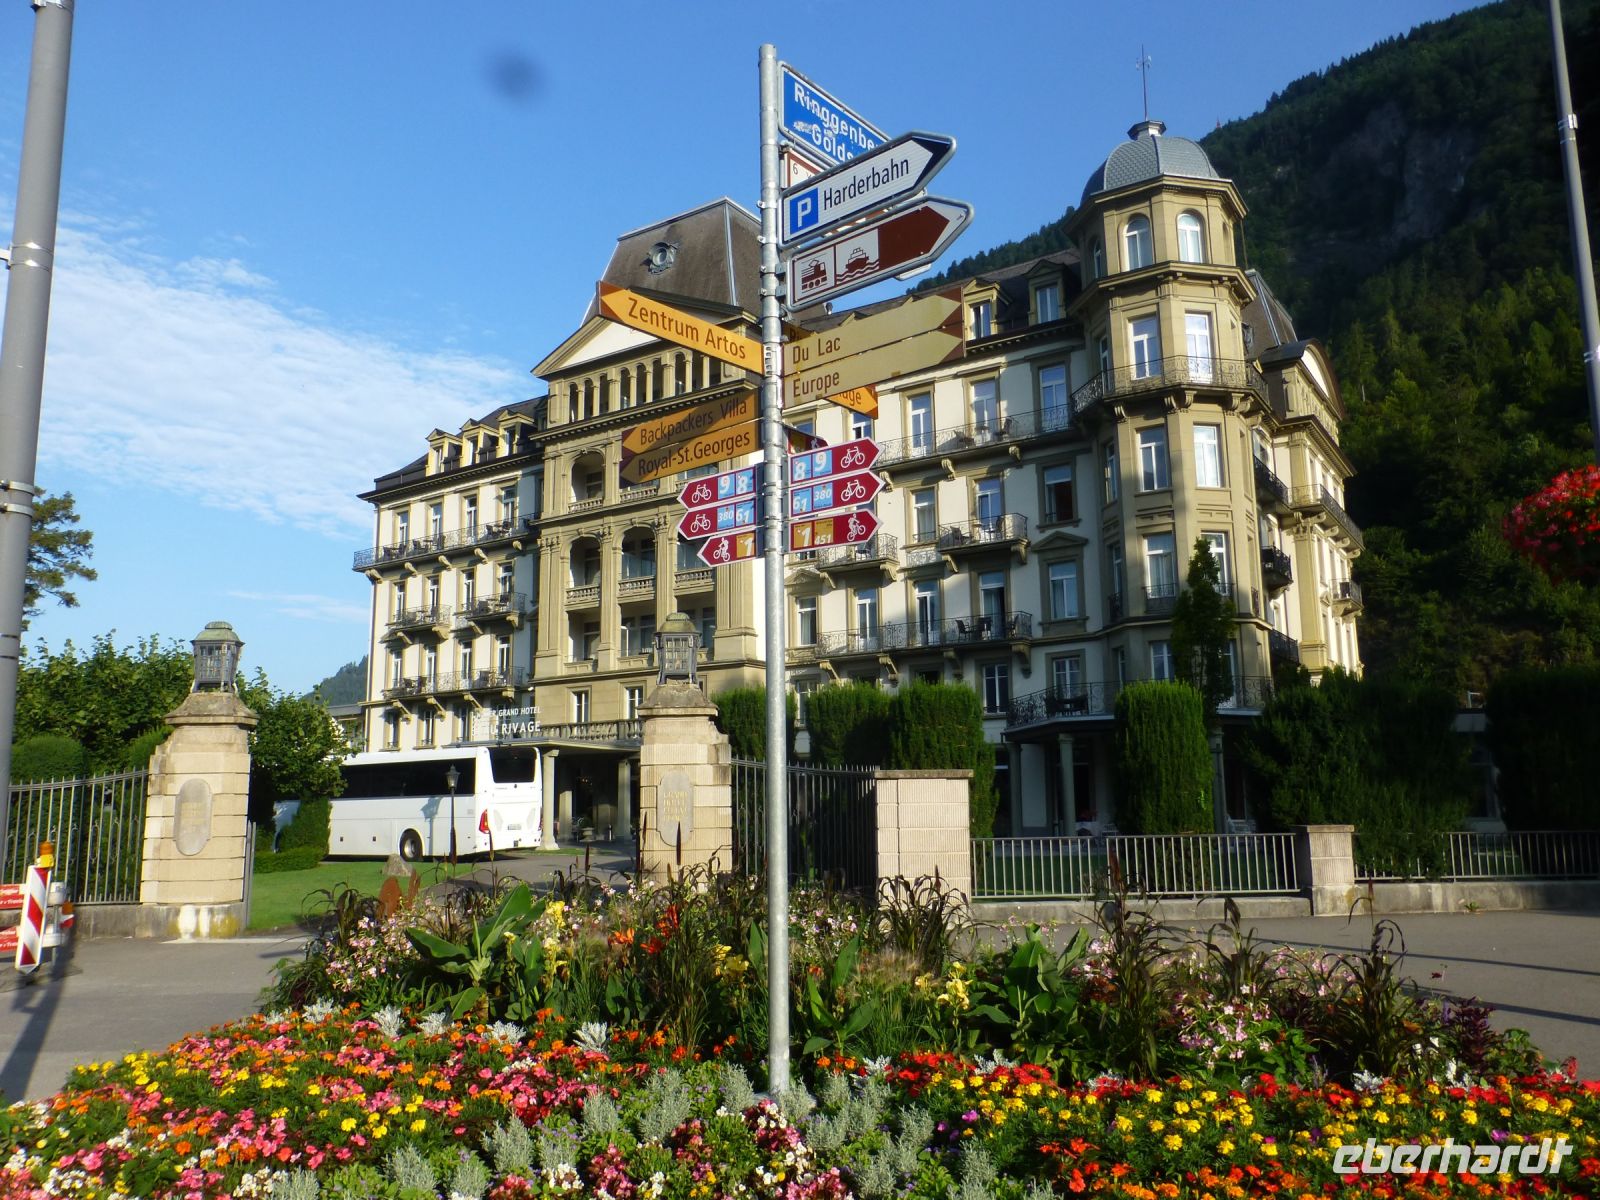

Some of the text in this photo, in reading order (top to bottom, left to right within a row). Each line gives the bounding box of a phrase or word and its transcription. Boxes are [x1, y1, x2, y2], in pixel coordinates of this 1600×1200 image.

[794, 82, 878, 150] Ringgenbe
[797, 158, 909, 228] P Harderbahn
[627, 297, 699, 343] Zentrum
[704, 327, 746, 360] Artos
[792, 337, 841, 365] Du Lac
[793, 371, 840, 398] Europe
[640, 397, 747, 446] Backpackers Villa
[638, 431, 750, 477] Royal-St.Georges
[794, 451, 827, 481] 8 9
[719, 475, 748, 495] 9 8
[793, 488, 832, 513] 61 380
[717, 508, 750, 525] 380 61
[744, 537, 754, 557] 1
[801, 527, 832, 547] 1 451
[498, 708, 519, 717] GRAND
[520, 706, 541, 715] HOTEL
[501, 721, 541, 736] RIVAGE
